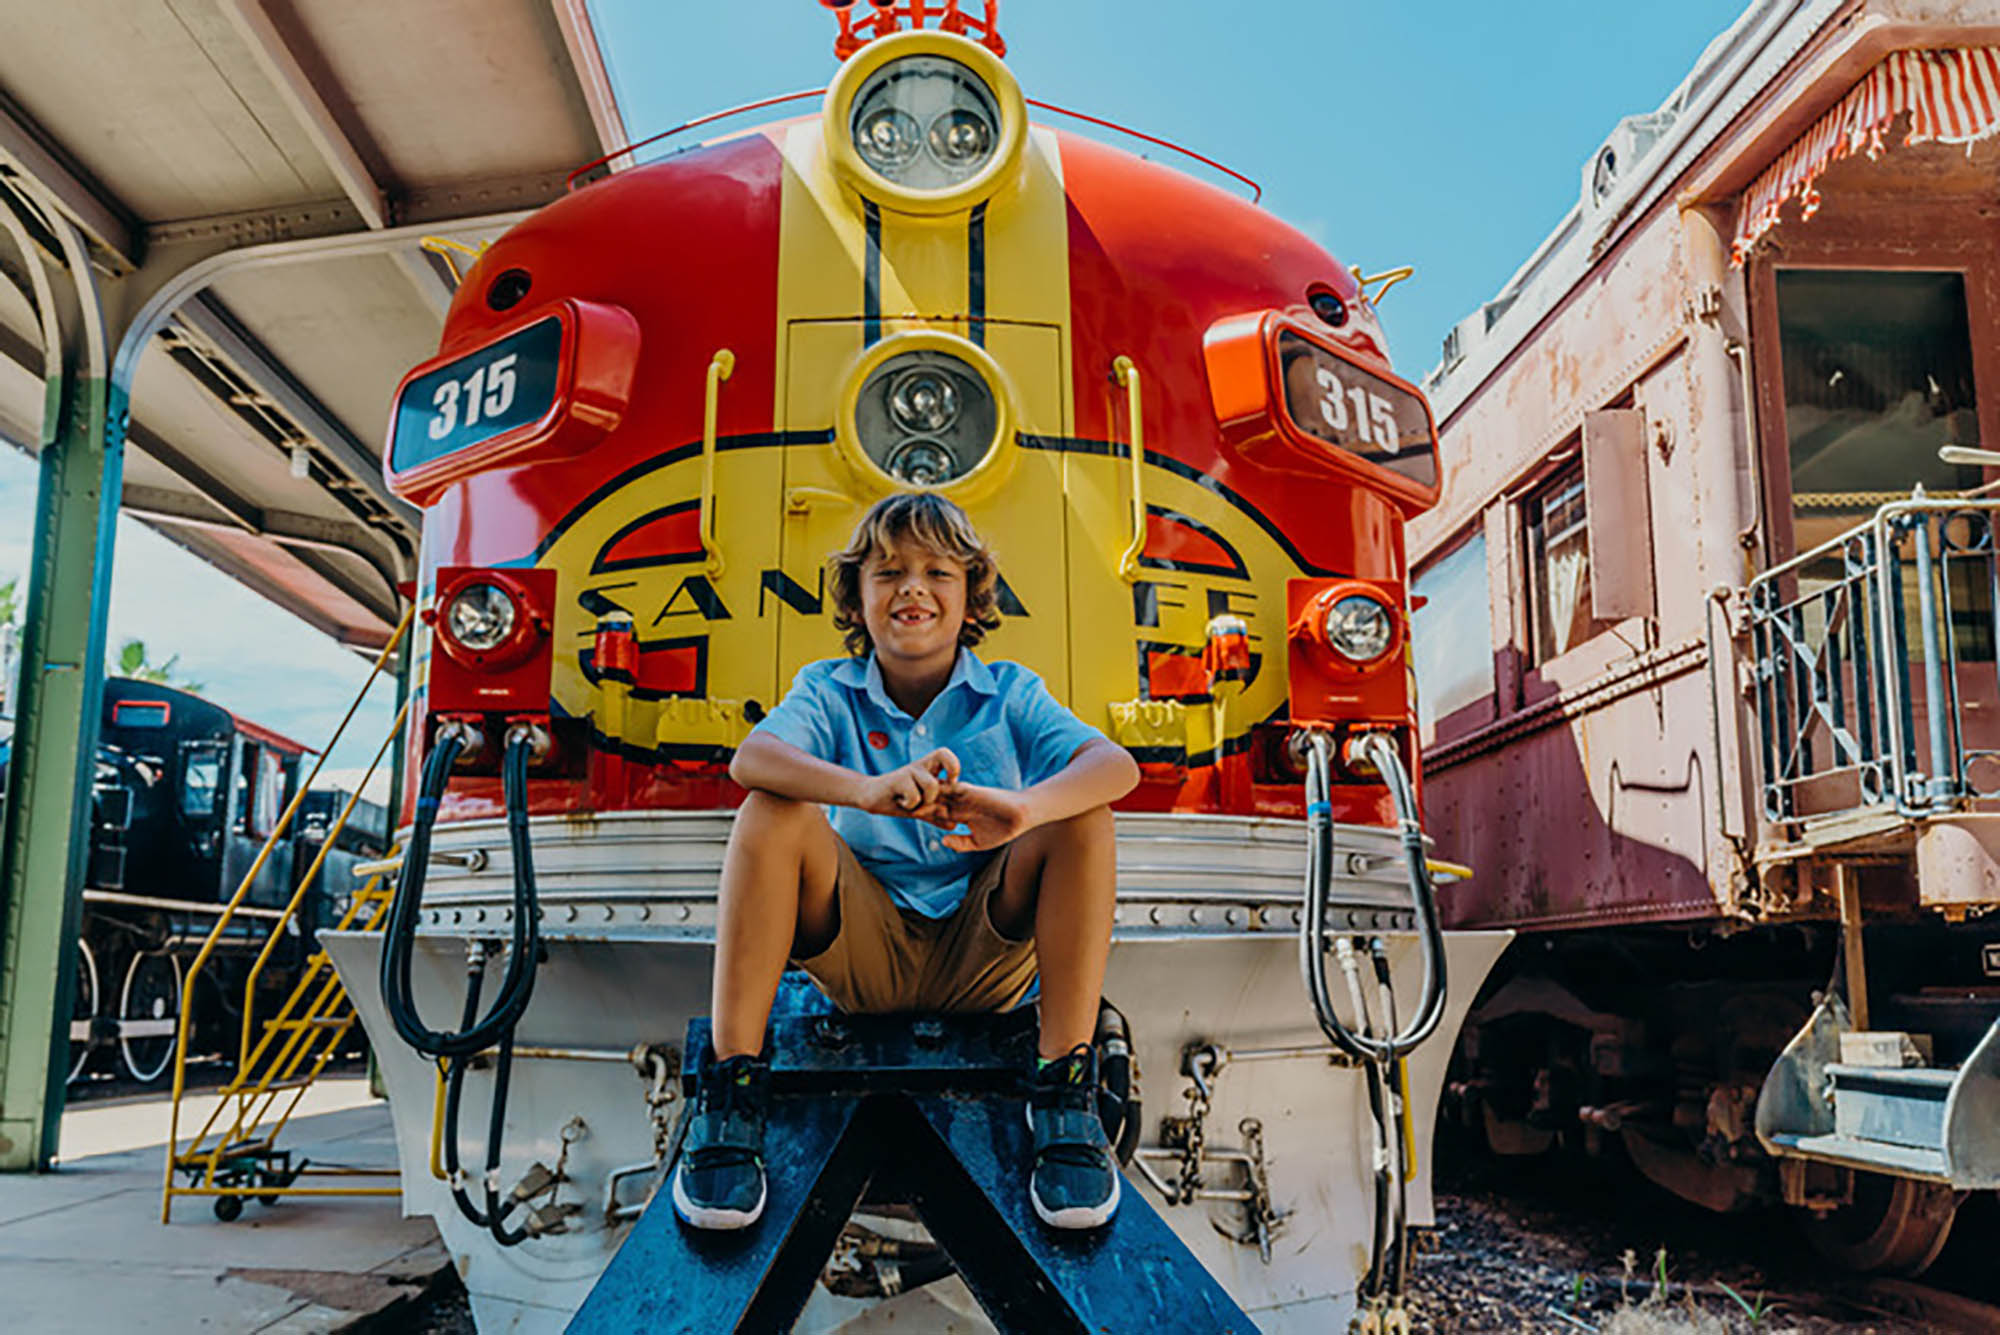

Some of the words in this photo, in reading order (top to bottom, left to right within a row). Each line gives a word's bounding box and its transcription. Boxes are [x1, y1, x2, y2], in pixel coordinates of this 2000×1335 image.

[428, 353, 518, 440] 315
[1316, 367, 1400, 454] 315
[1132, 579, 1262, 641] FE
